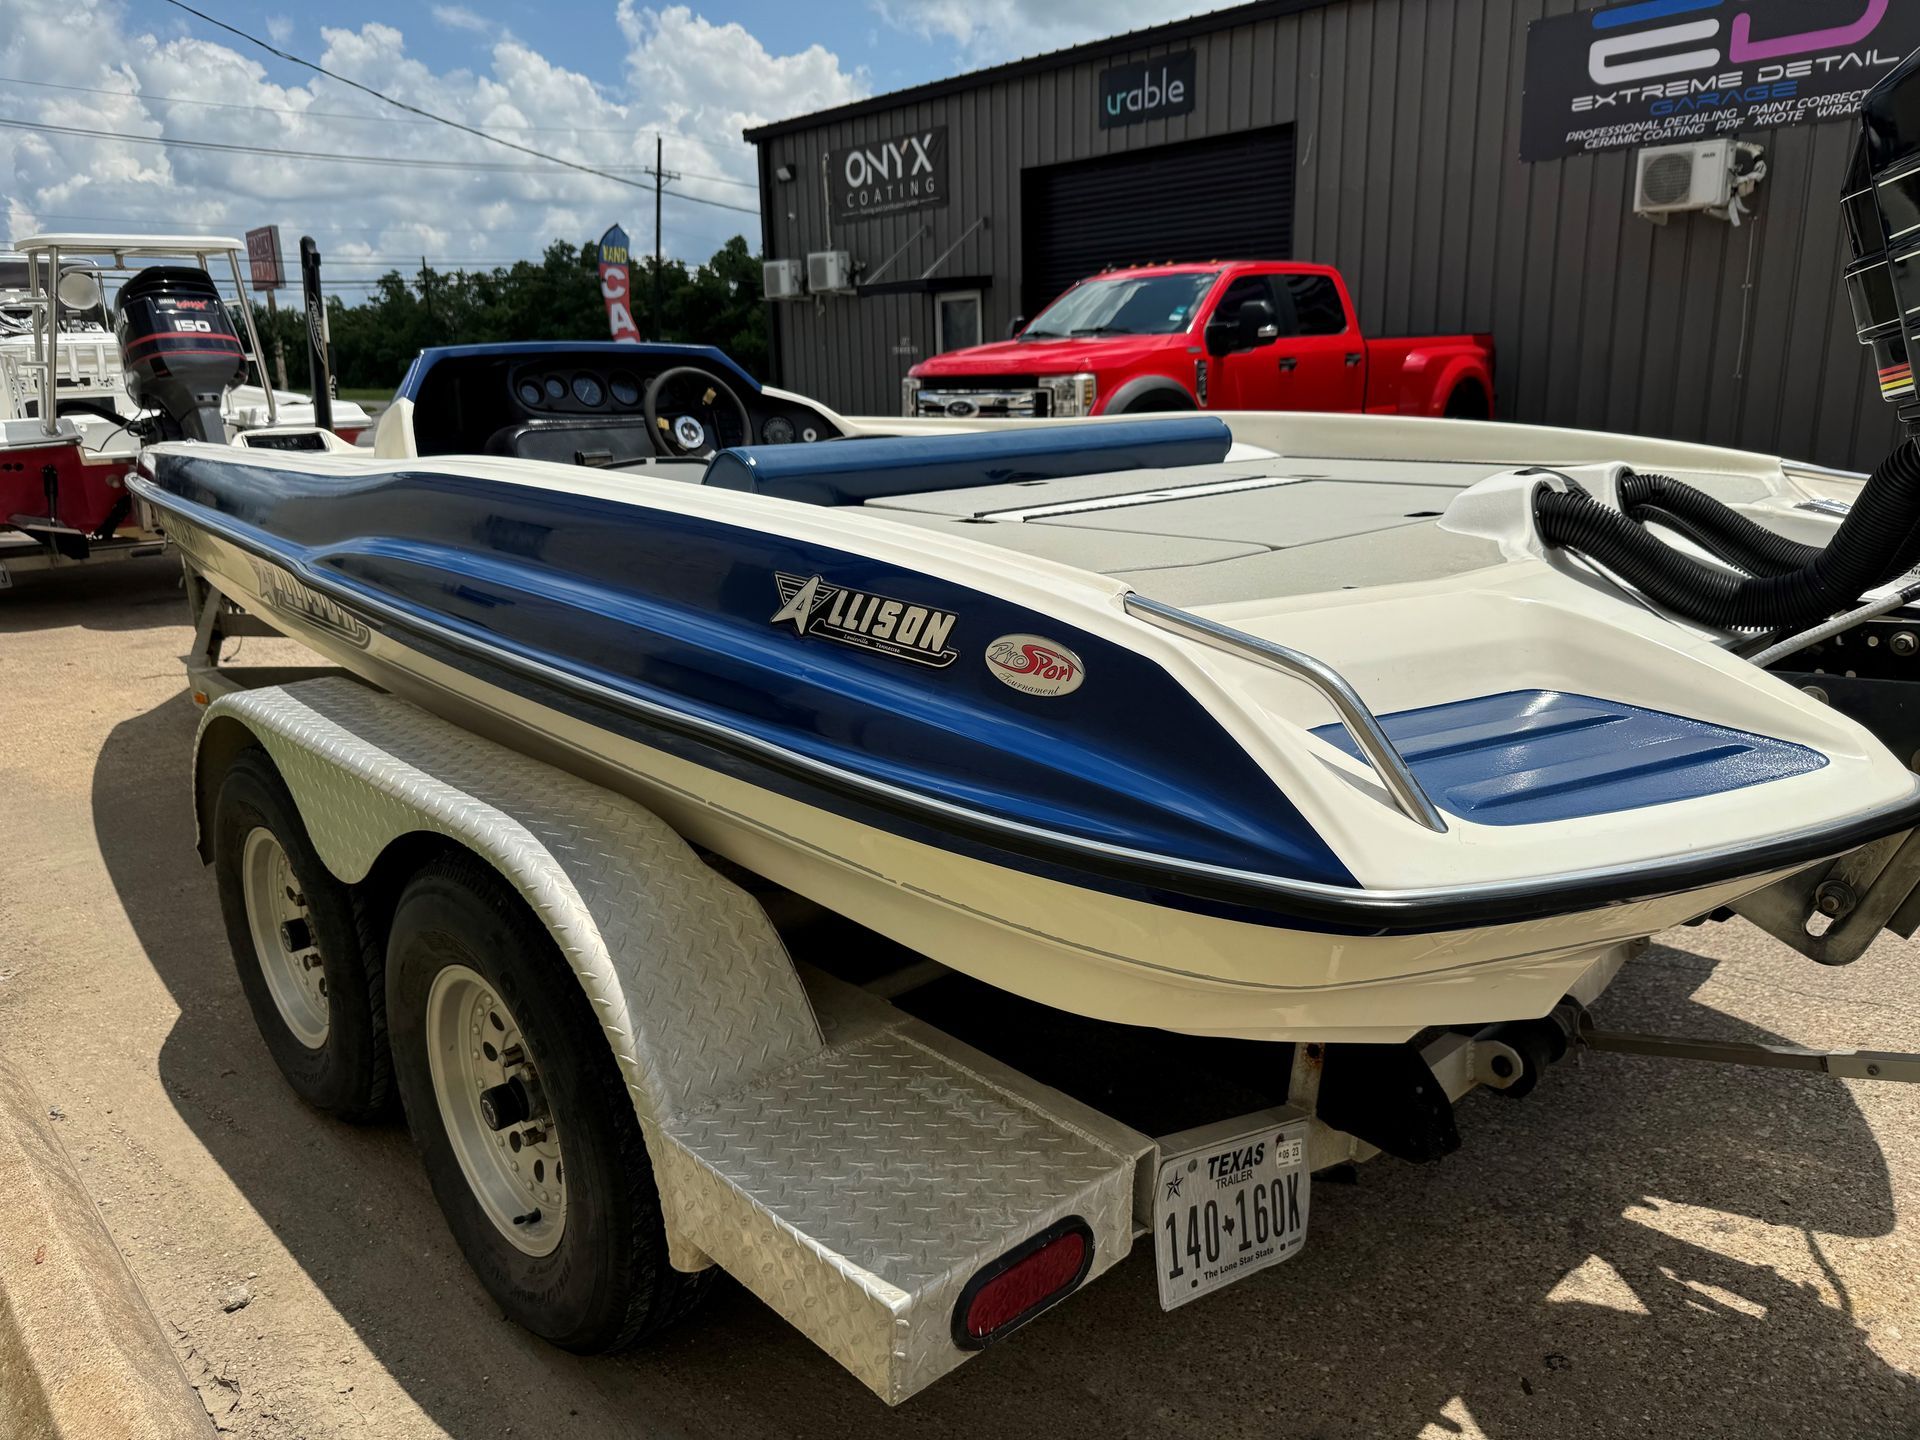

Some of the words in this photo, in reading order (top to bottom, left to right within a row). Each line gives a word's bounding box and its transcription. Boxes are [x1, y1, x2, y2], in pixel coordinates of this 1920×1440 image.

[1106, 67, 1184, 115] urable
[1571, 71, 1743, 112] EXTREME
[1757, 48, 1900, 83] DETAIL
[1650, 80, 1798, 116] GARAGE
[1565, 119, 1661, 142] PROFESSIONAL
[1663, 107, 1738, 129] DETAILING
[1747, 99, 1796, 117] PAINT
[1584, 131, 1641, 150] CERAMIC
[1643, 123, 1705, 142] COATING
[1715, 116, 1746, 132] PPF
[1753, 108, 1805, 127] XKOTE
[845, 133, 933, 188] ONYX
[846, 176, 935, 208] COATING
[174, 319, 212, 333] 150
[771, 575, 956, 652] ALLISON
[998, 672, 1060, 695] Tournament
[1207, 1142, 1265, 1180] TEXAS
[1215, 1169, 1253, 1190] TRAILER
[1203, 1269, 1218, 1280] The
[1219, 1261, 1238, 1274] Lone
[1239, 1254, 1254, 1266] Star
[1255, 1247, 1274, 1259] State
